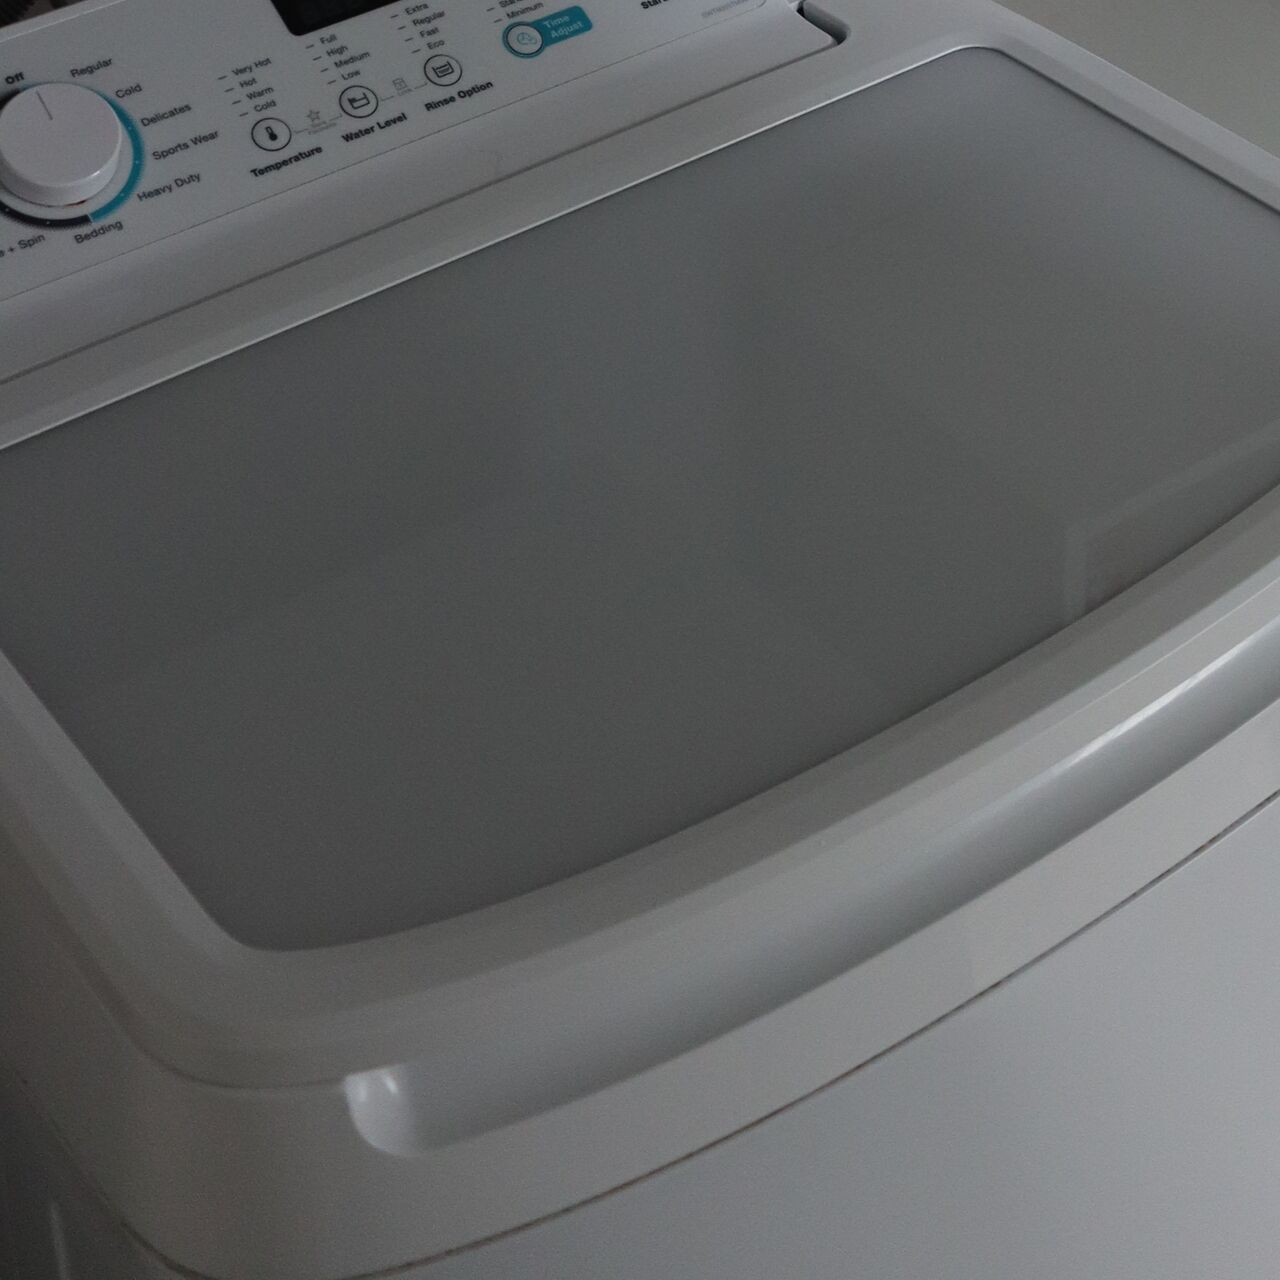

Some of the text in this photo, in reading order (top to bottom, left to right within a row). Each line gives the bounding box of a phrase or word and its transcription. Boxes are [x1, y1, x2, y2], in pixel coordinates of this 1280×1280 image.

[405, 2, 429, 15] Extra
[507, 2, 543, 19] Minimum
[412, 10, 445, 27] Regular
[544, 15, 570, 29] Time
[420, 27, 440, 38] Fast
[550, 22, 583, 39] Adjust
[320, 34, 337, 45] Full
[427, 39, 445, 49] Eco
[327, 44, 348, 58] High
[334, 51, 370, 68] Medium
[70, 57, 112, 79] Regular
[232, 57, 271, 77] Very Hot
[342, 70, 361, 81] Low
[5, 71, 25, 85] Off
[240, 77, 257, 88] Hot
[116, 84, 142, 99] Cold
[247, 87, 274, 101] Warm
[425, 92, 455, 112] Rinse
[457, 80, 493, 100] Option
[254, 100, 276, 112] Cold
[141, 103, 192, 127] Delicates
[342, 125, 375, 143] Water
[377, 113, 407, 130] Level
[152, 130, 219, 161] Sports Wear
[250, 145, 323, 178] Temperature
[137, 172, 202, 202] Heavy Duty
[75, 220, 123, 244] Bedding
[18, 233, 45, 250] Spin
